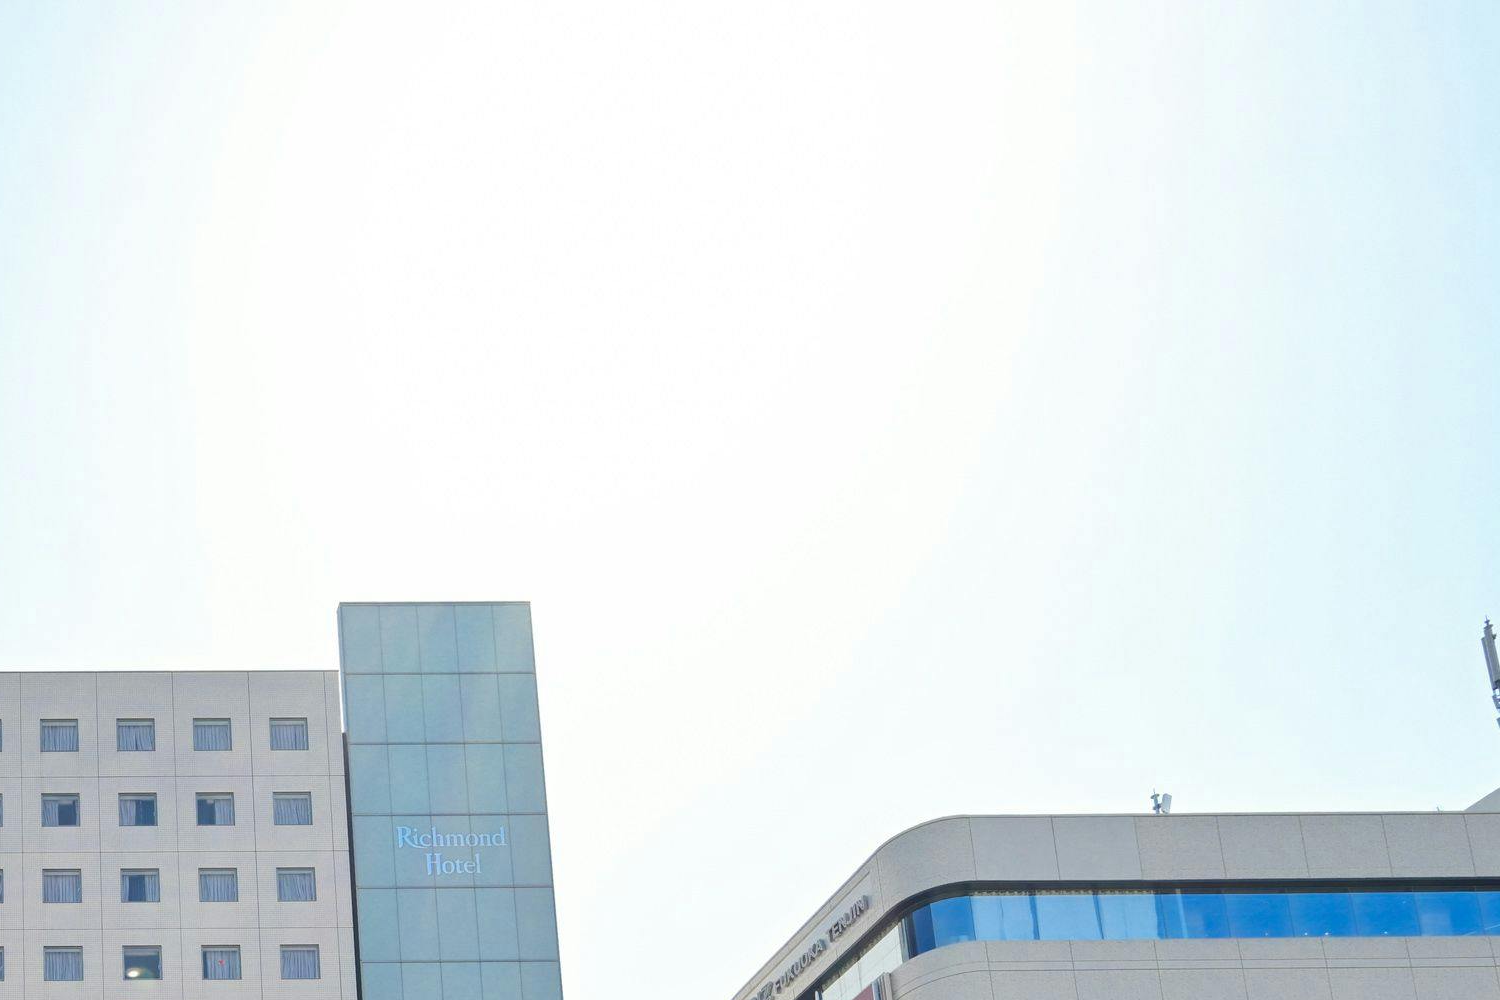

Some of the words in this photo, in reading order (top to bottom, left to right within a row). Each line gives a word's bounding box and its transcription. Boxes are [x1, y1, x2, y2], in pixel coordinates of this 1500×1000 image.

[395, 825, 508, 849] Richmond
[425, 852, 483, 875] Hotel
[775, 938, 827, 994] FUKUOKA
[827, 895, 871, 943] TENJIN
